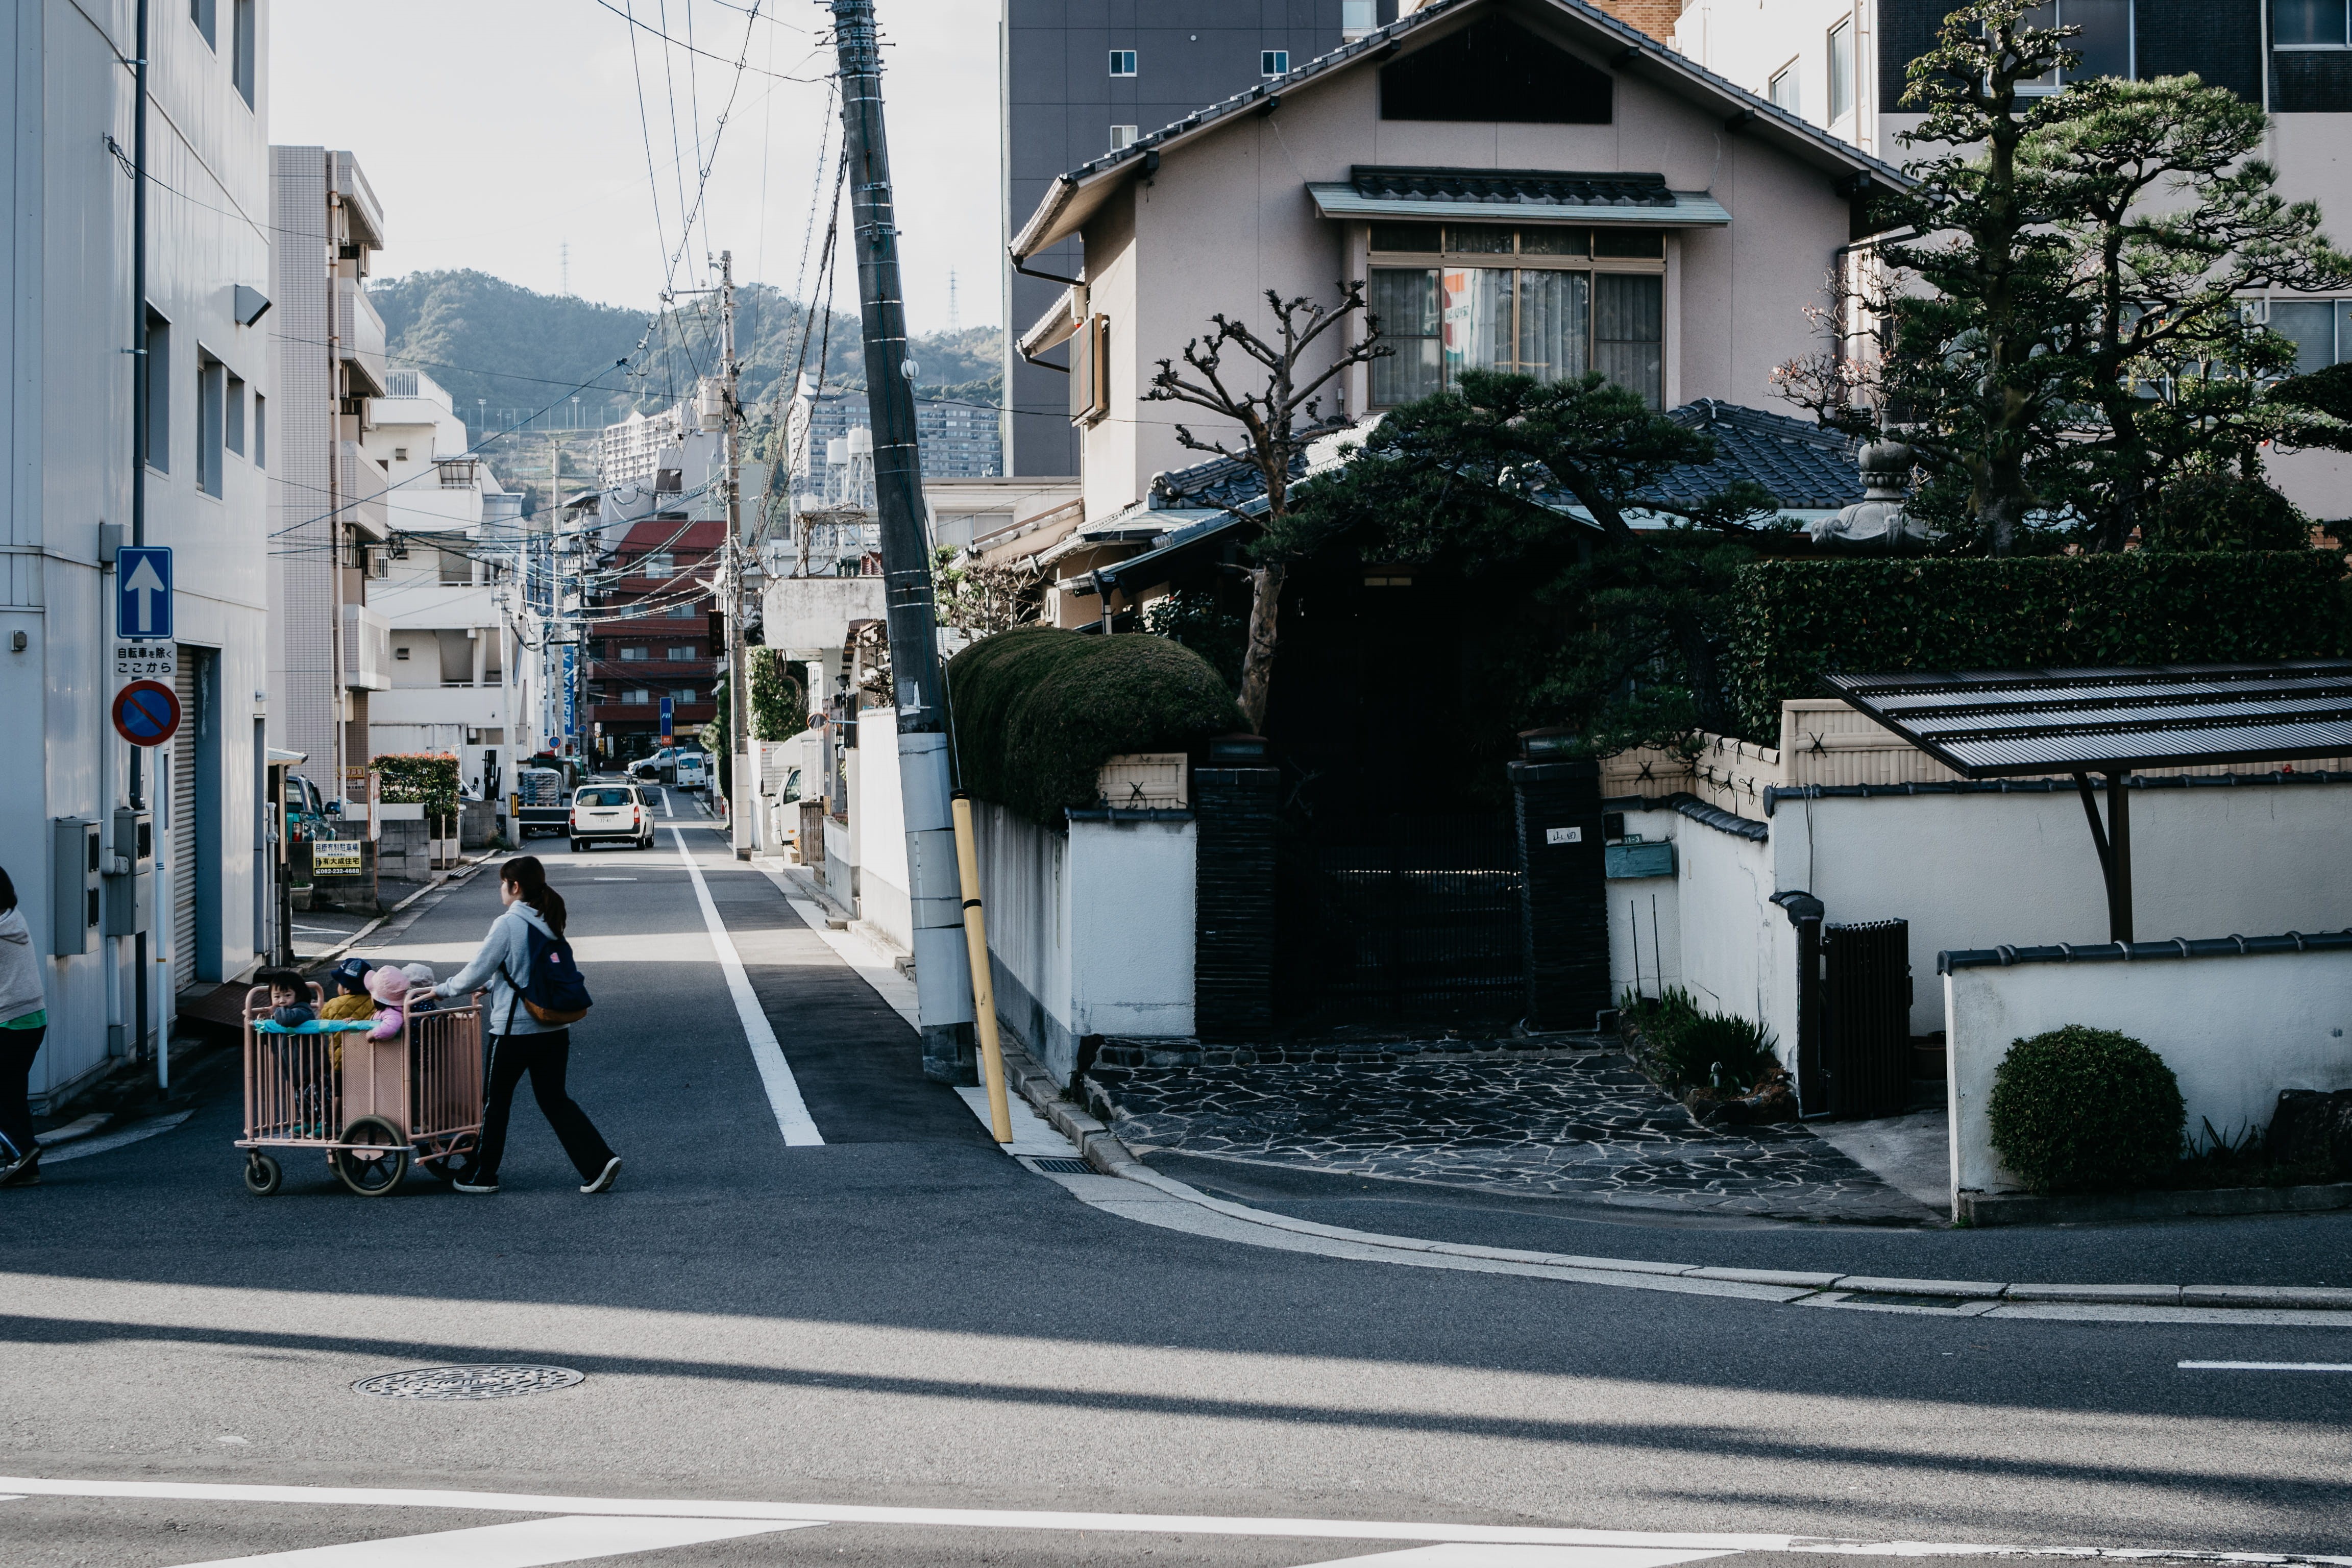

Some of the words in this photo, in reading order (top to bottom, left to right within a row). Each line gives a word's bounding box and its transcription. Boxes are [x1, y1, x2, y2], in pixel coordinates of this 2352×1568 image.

[118, 647, 172, 658] 自転車を除く
[118, 662, 172, 673] ここから
